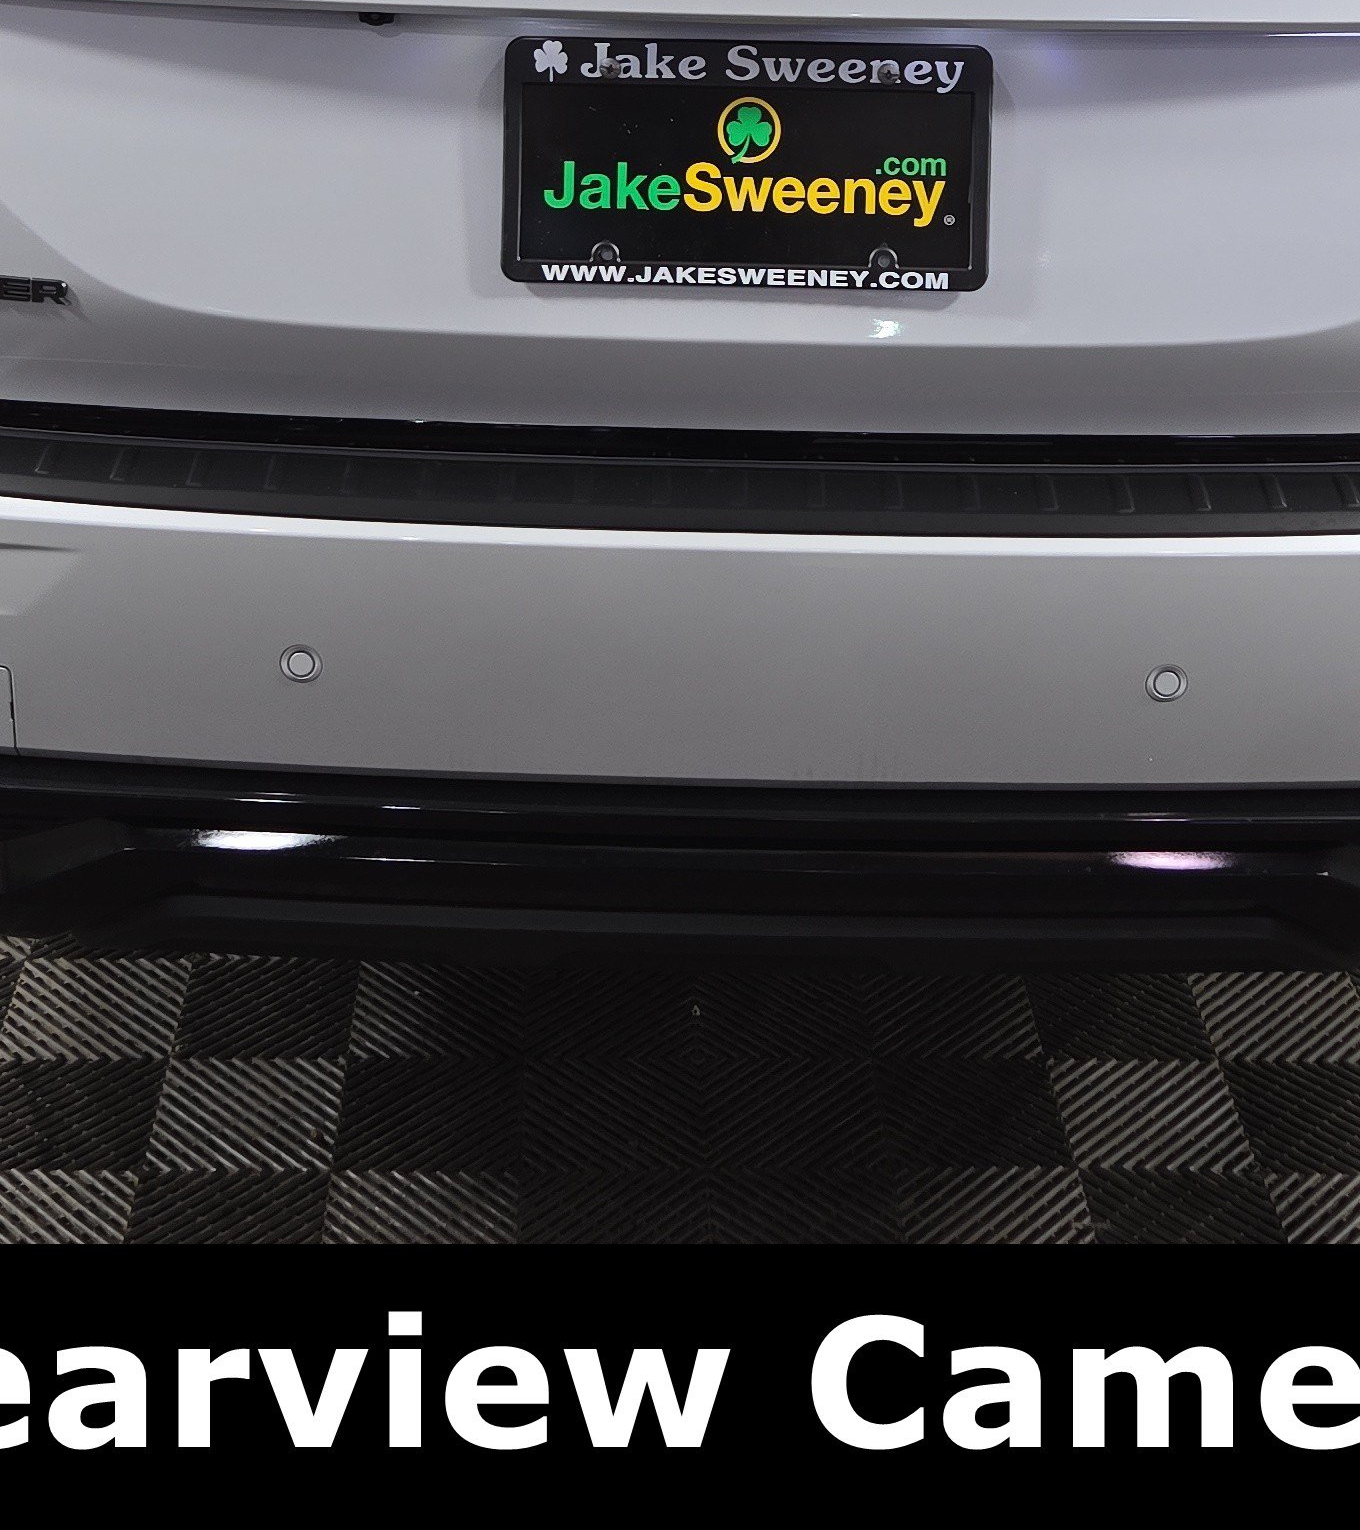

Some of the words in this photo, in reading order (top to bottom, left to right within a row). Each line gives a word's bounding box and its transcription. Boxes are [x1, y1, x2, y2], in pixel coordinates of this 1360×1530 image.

[580, 42, 707, 81] Jake
[725, 45, 965, 93] Sweeney
[541, 263, 950, 290] WWW.JAKESWEENEY.COM
